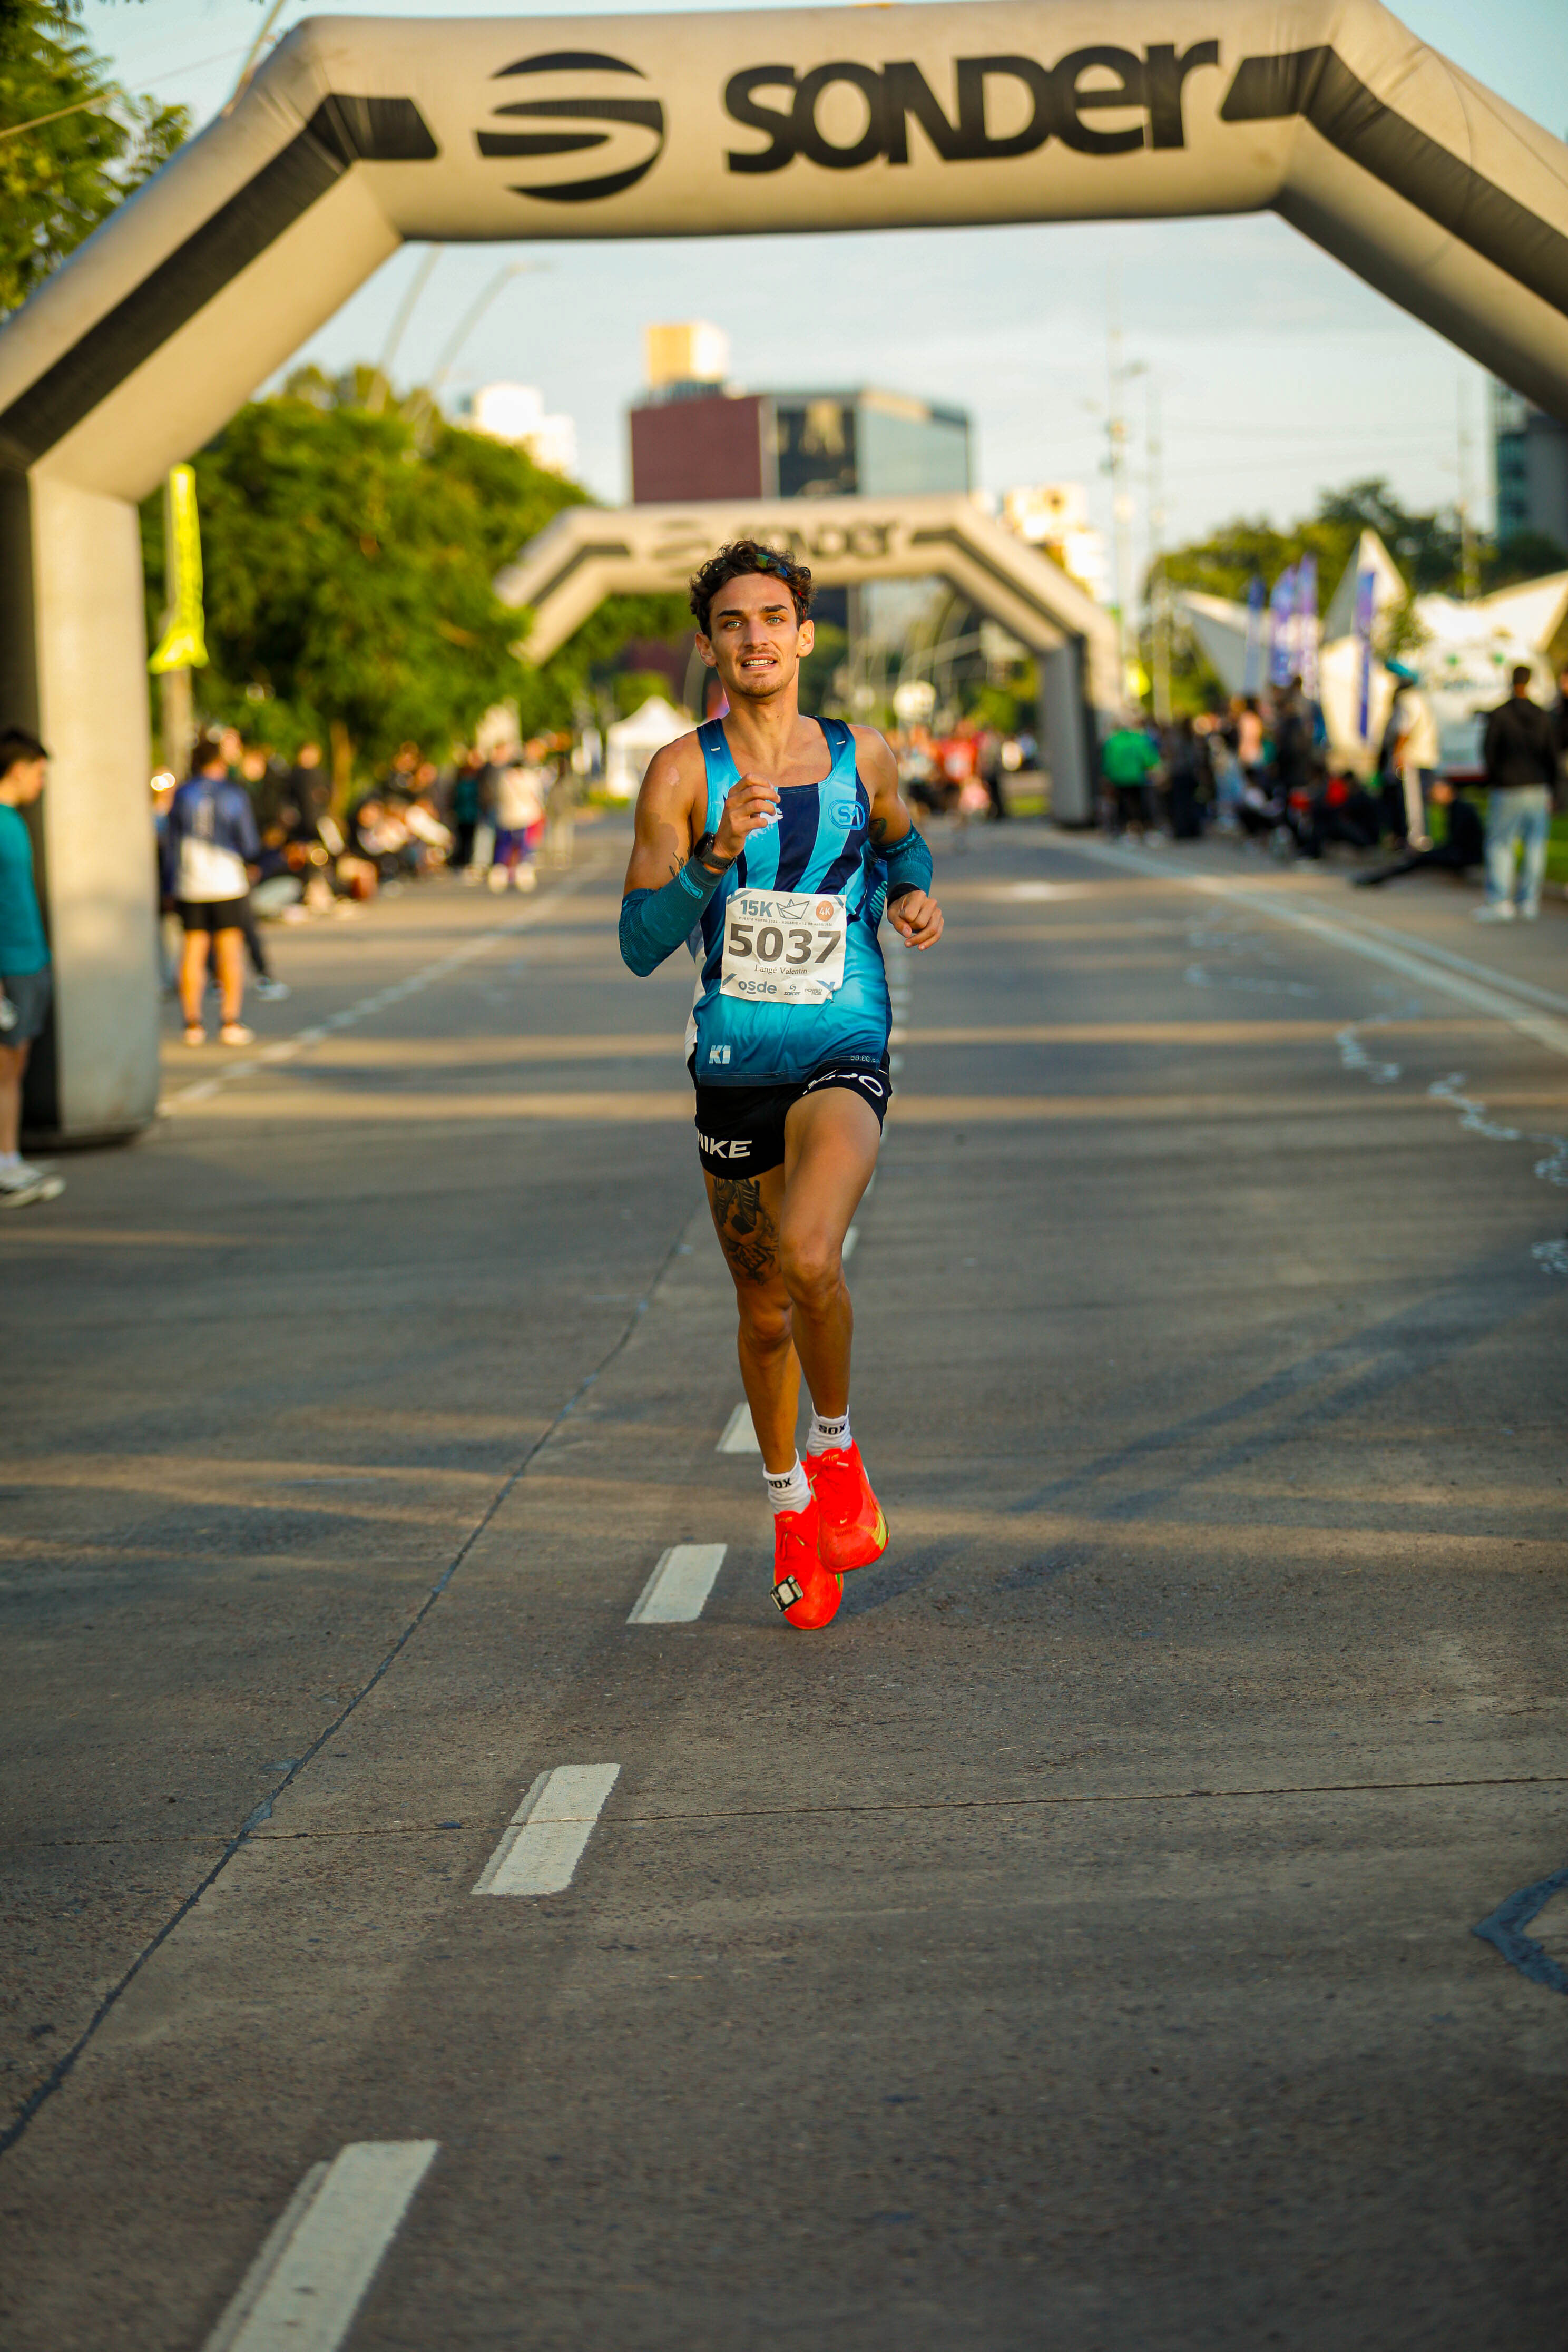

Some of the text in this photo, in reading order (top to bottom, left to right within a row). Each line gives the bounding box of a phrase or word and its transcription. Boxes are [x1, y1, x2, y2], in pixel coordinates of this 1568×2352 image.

[740, 899, 773, 917] 15K
[819, 906, 831, 916] 4K
[729, 923, 841, 964] 5037
[754, 964, 777, 974] Langé
[738, 981, 777, 994] osde
[709, 1045, 731, 1064] K1
[697, 1129, 752, 1158] NIKE
[819, 1423, 845, 1435] SOX
